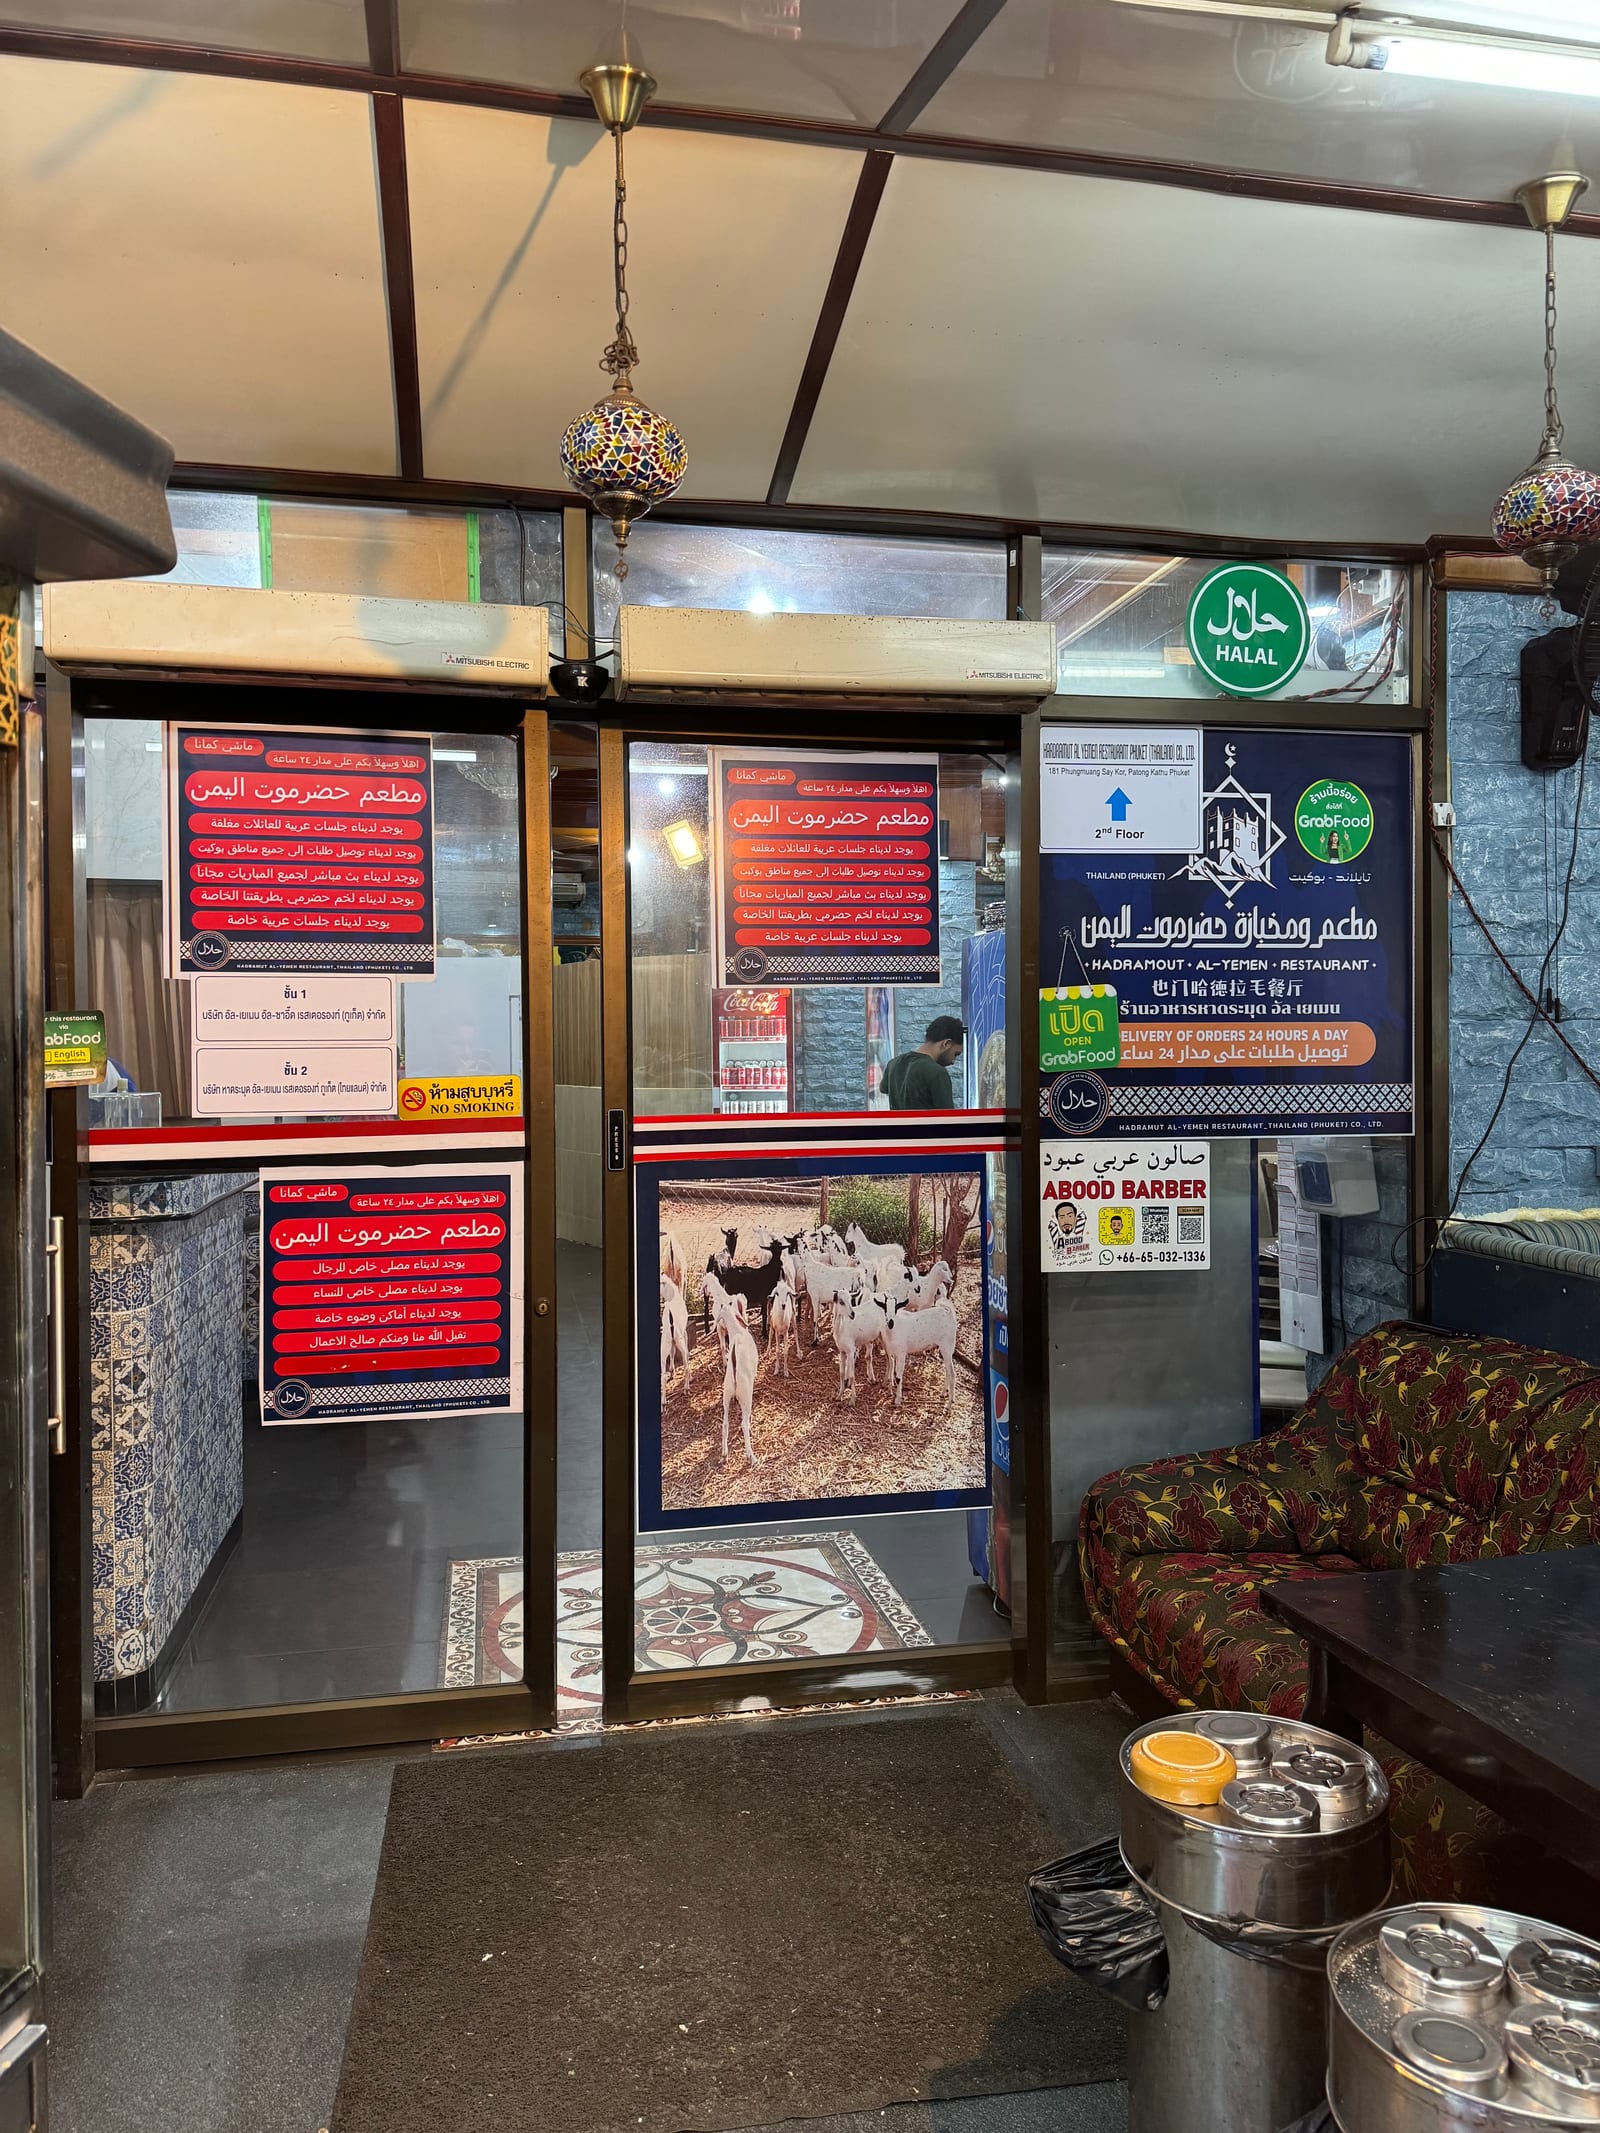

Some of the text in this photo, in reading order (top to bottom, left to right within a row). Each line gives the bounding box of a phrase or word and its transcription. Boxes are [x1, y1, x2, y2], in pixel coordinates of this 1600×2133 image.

[1207, 587, 1288, 641] حلال
[1216, 644, 1278, 666] HALAL
[456, 658, 529, 669] MITSUBISHI ELECTRIC
[1061, 768, 1100, 777] Phungmuang
[1128, 769, 1149, 777] Patong
[191, 776, 421, 807] مطعم حضرموت اليمن
[1309, 783, 1358, 804] ร้านนี้อร่อย
[733, 805, 928, 830] مطعم حضرموت اليمن
[1298, 814, 1370, 828] GrabFood
[1095, 827, 1144, 839] 2nd Floor
[1086, 872, 1166, 881] THAILAND (PHUKET)
[1289, 872, 1371, 884] تايلاند بوكيت
[1082, 904, 1131, 948] اليمن
[1116, 912, 1227, 948] حضرموت
[1310, 906, 1378, 948] مطعم
[1093, 959, 1369, 971] HADRAMOUT AL-YEMEN RESTAURANT
[284, 985, 307, 999] ชั้น 1
[1152, 979, 1304, 998] 也门哈德拉毛餐厅
[1120, 1000, 1340, 1018] ร้านอาหารหาดระมุด อัล-เยเมน
[45, 1032, 101, 1046] abFood
[1064, 1036, 1092, 1046] OPEN
[1120, 1029, 1348, 1042] ELIVERY OF ORDERS 24 HOURS A DAY
[1042, 1047, 1115, 1066] GrabFood
[1159, 1048, 1174, 1060] 24
[1177, 1047, 1210, 1063] مدار
[1214, 1046, 1245, 1063] على
[1250, 1046, 1294, 1060] طلبات
[1298, 1044, 1348, 1062] توصيل
[284, 1062, 308, 1076] ชั้น 2
[429, 1079, 514, 1102] ห้ามสูบบุหรี่
[1062, 1089, 1098, 1110] حلال
[431, 1102, 514, 1114] NO SMOKING
[1311, 1121, 1348, 1129] (PHUKET)
[1044, 1144, 1205, 1179] صالون عربي عبود
[280, 1186, 337, 1199] ماشي كمانا
[1042, 1180, 1206, 1200] ABOOD BARBER
[275, 1219, 500, 1249] مطعم حضرموت اليمن
[1116, 1252, 1206, 1263] +66-65-032-1336
[313, 1258, 464, 1274] يوجد لديناء مصلى خاص للرجال
[313, 1283, 462, 1298] يوجد لديناء مصلى خاص للنساء
[315, 1306, 461, 1324] يوجد لديناء أماكن وضوء خاصة
[309, 1329, 466, 1348] تقبل الله منا ومنكم صالح الاعمال
[280, 1391, 304, 1403] حلال
